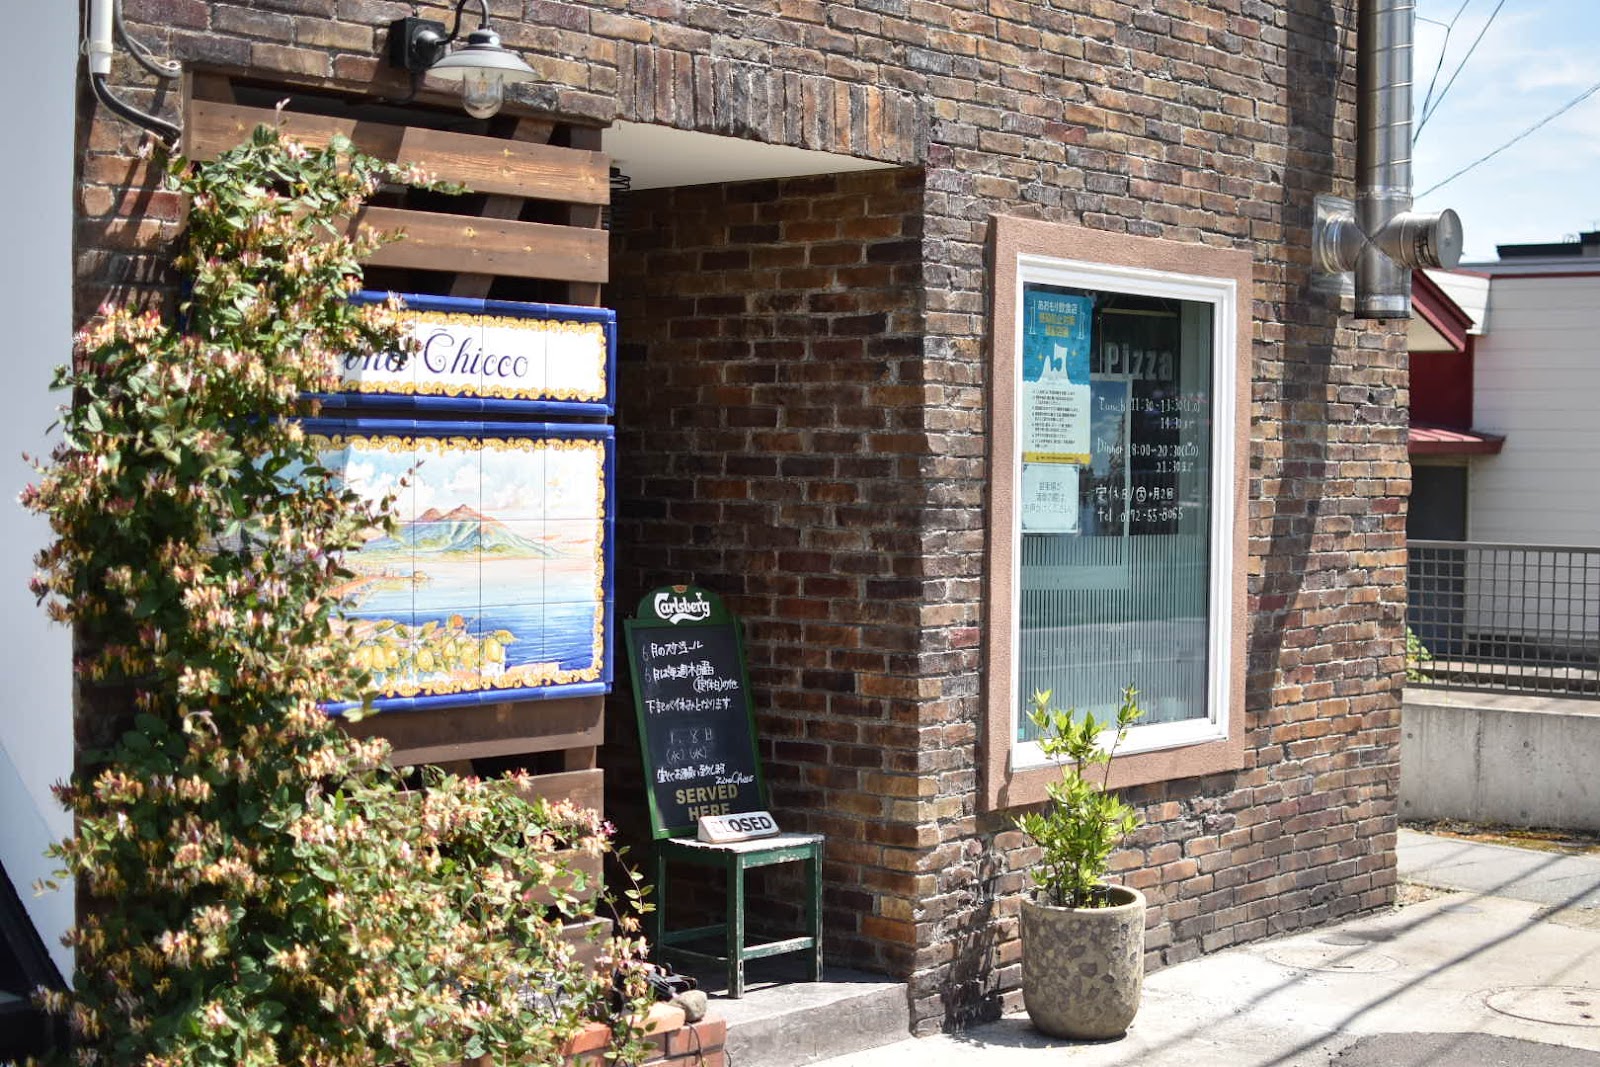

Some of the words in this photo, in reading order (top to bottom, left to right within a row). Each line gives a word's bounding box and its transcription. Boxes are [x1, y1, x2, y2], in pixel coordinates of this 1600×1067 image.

[423, 328, 528, 377] Chicco
[1104, 342, 1173, 380] Pizza
[1097, 436, 1123, 455] Dinner
[654, 592, 711, 625] Carlsberg
[675, 784, 738, 804] SERVED
[688, 802, 730, 821] HERE
